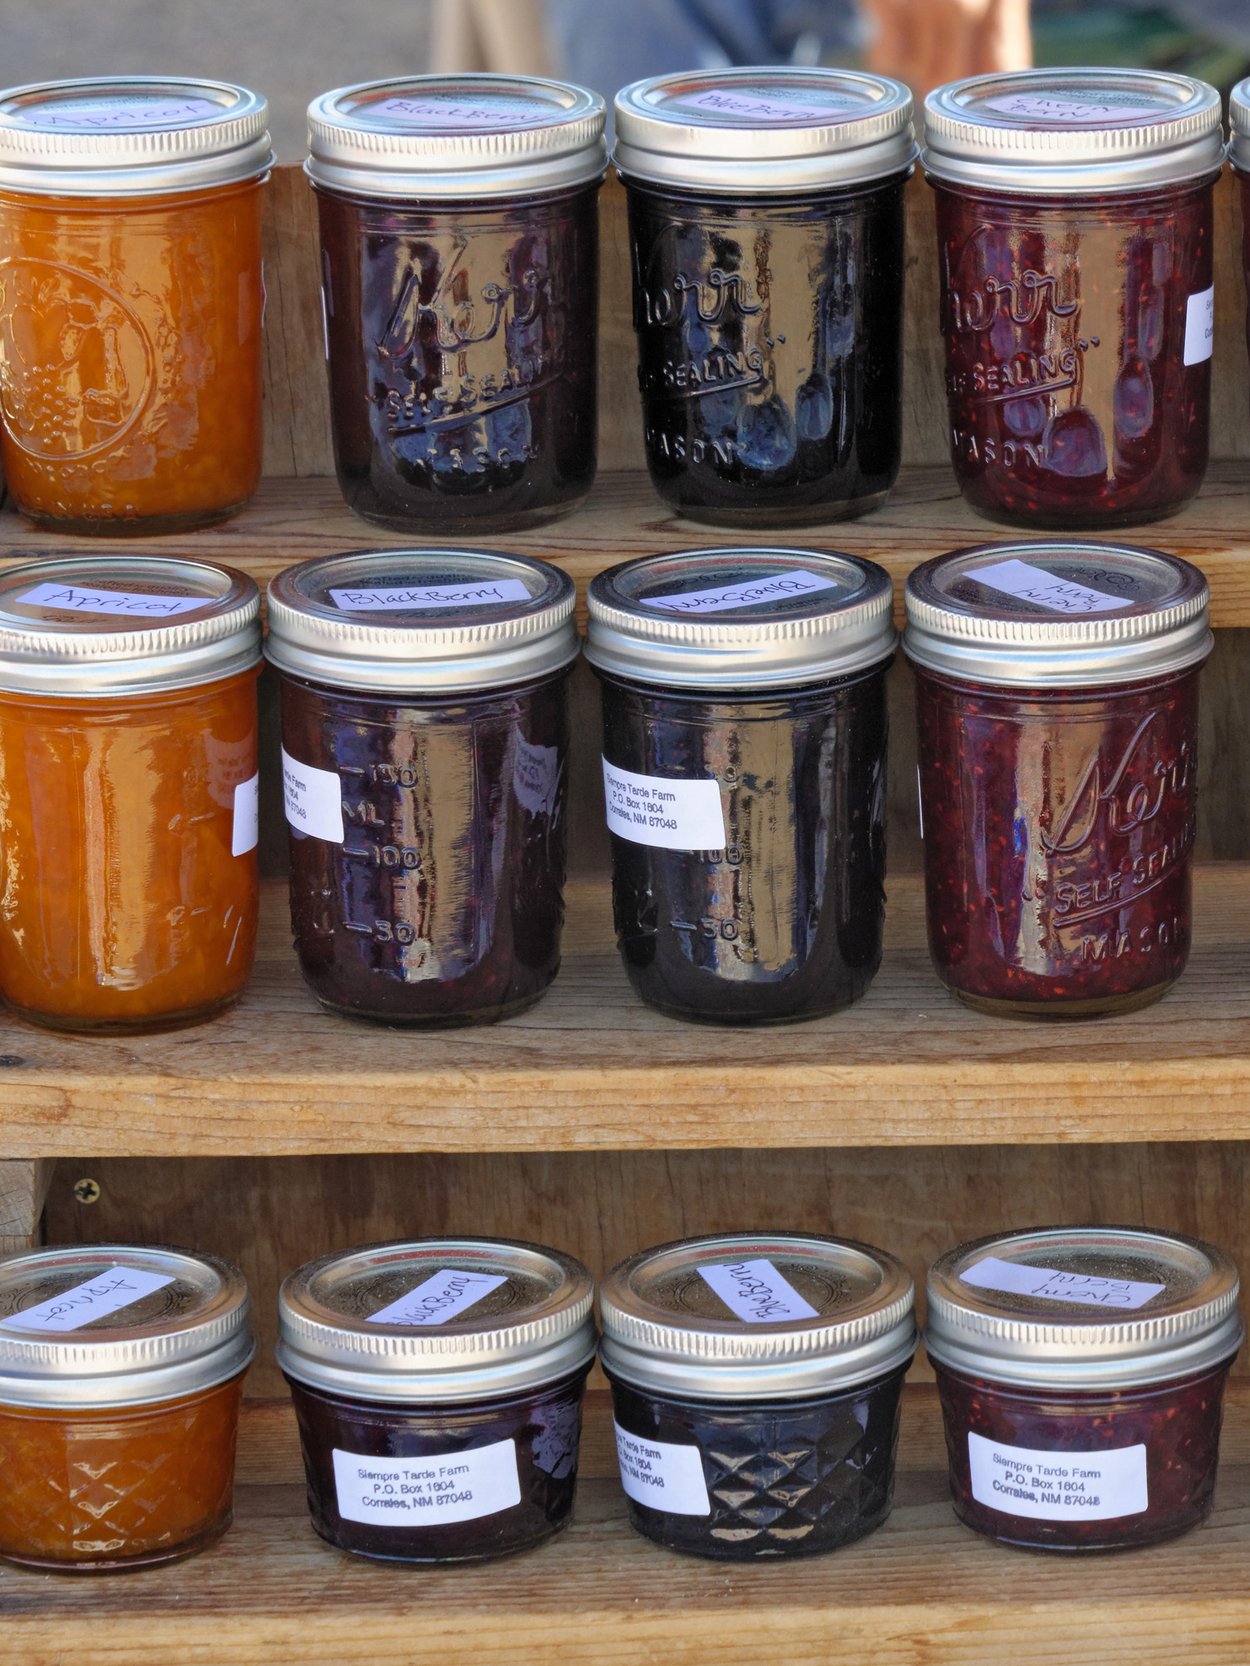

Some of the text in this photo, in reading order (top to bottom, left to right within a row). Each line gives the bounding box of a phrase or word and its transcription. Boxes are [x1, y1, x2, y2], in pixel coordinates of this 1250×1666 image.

[44, 589, 183, 612] Apricot
[628, 783, 650, 798] Tarde
[652, 789, 676, 802] Farm
[626, 796, 641, 810] Box
[633, 813, 648, 825] NM
[649, 816, 678, 830] 87048
[640, 1445, 662, 1460] Farm
[357, 1464, 469, 1483] Siempre Tarde Farm
[992, 1452, 1101, 1479] Siempre Tarde Farm
[373, 1483, 397, 1495] P.O.
[400, 1483, 423, 1494] Box
[1004, 1471, 1028, 1485] P.O.
[1031, 1477, 1053, 1489] Box
[362, 1490, 473, 1510] Corrales, NM 87048
[992, 1480, 1101, 1506] Corrales, NM 87048
